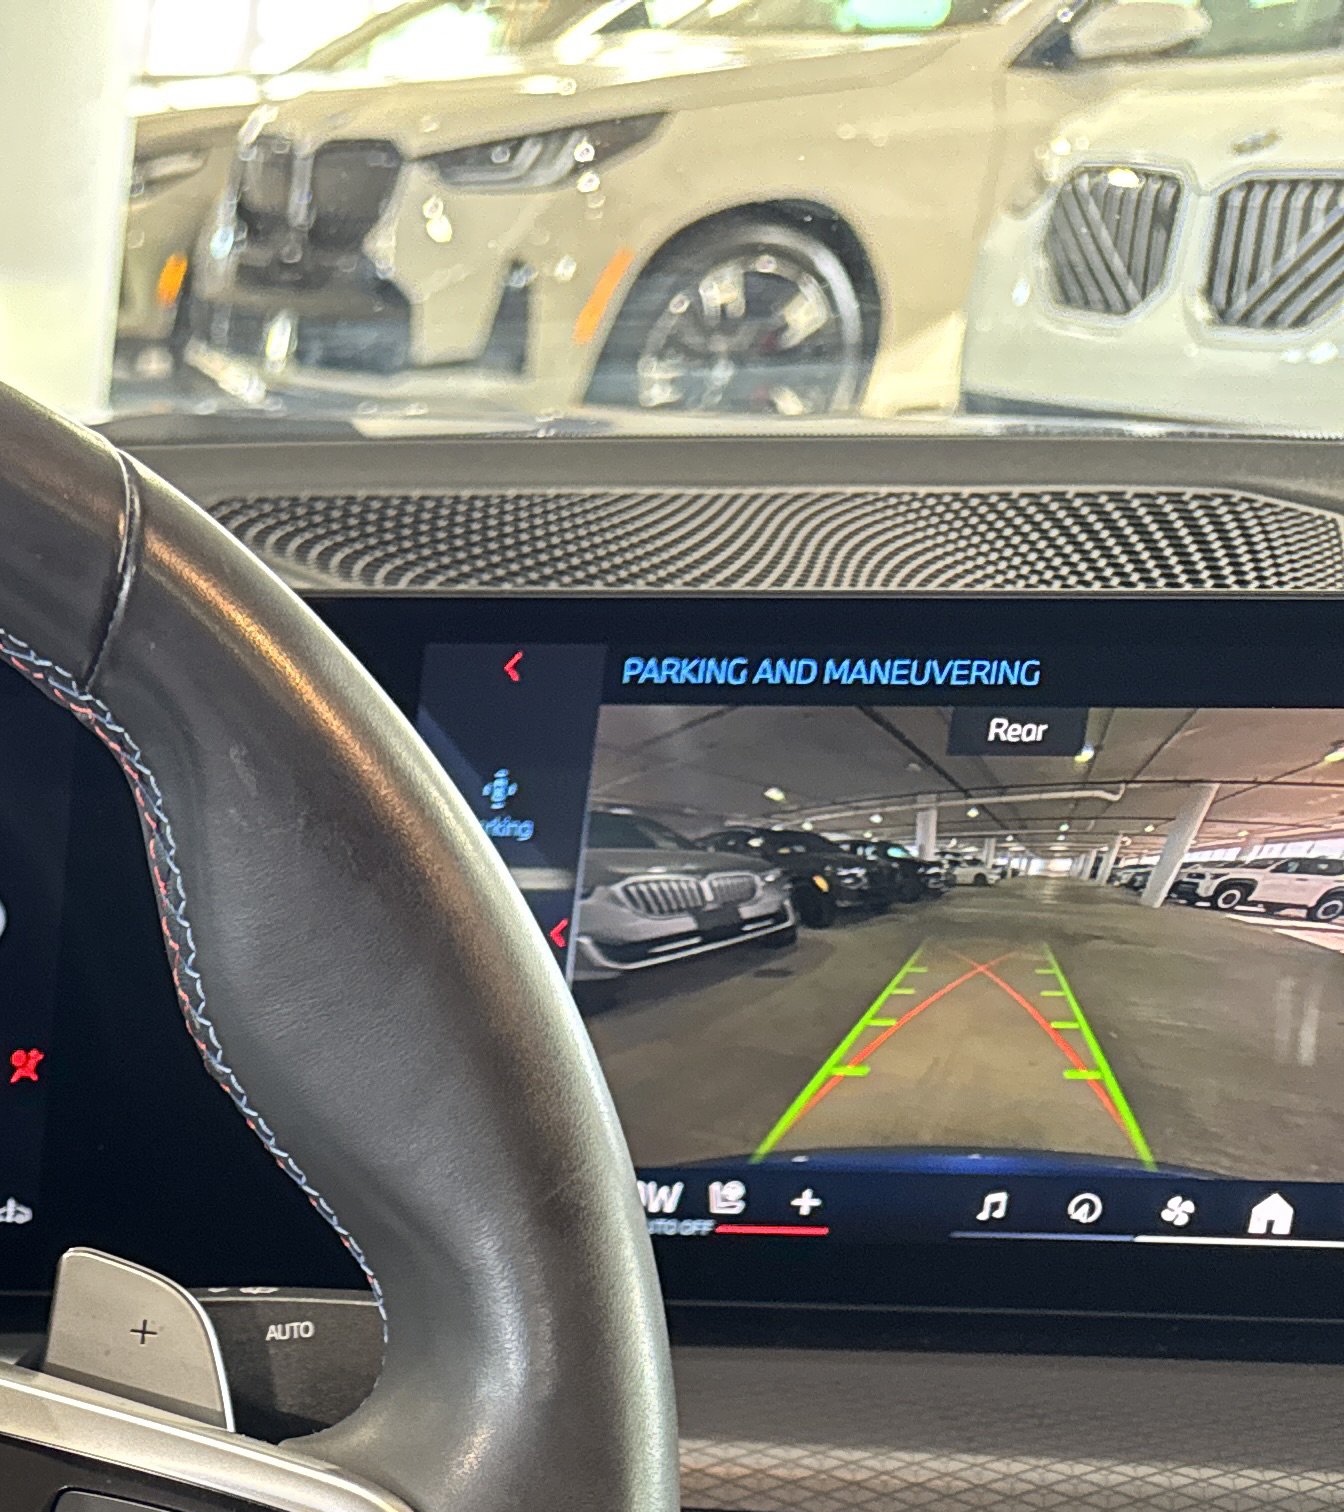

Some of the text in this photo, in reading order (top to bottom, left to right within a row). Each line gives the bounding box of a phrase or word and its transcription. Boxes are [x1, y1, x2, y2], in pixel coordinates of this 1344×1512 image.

[623, 656, 1041, 686] PARKING AND MANEUVERING
[987, 717, 1049, 743] Rear
[265, 1320, 315, 1341] AUTO
